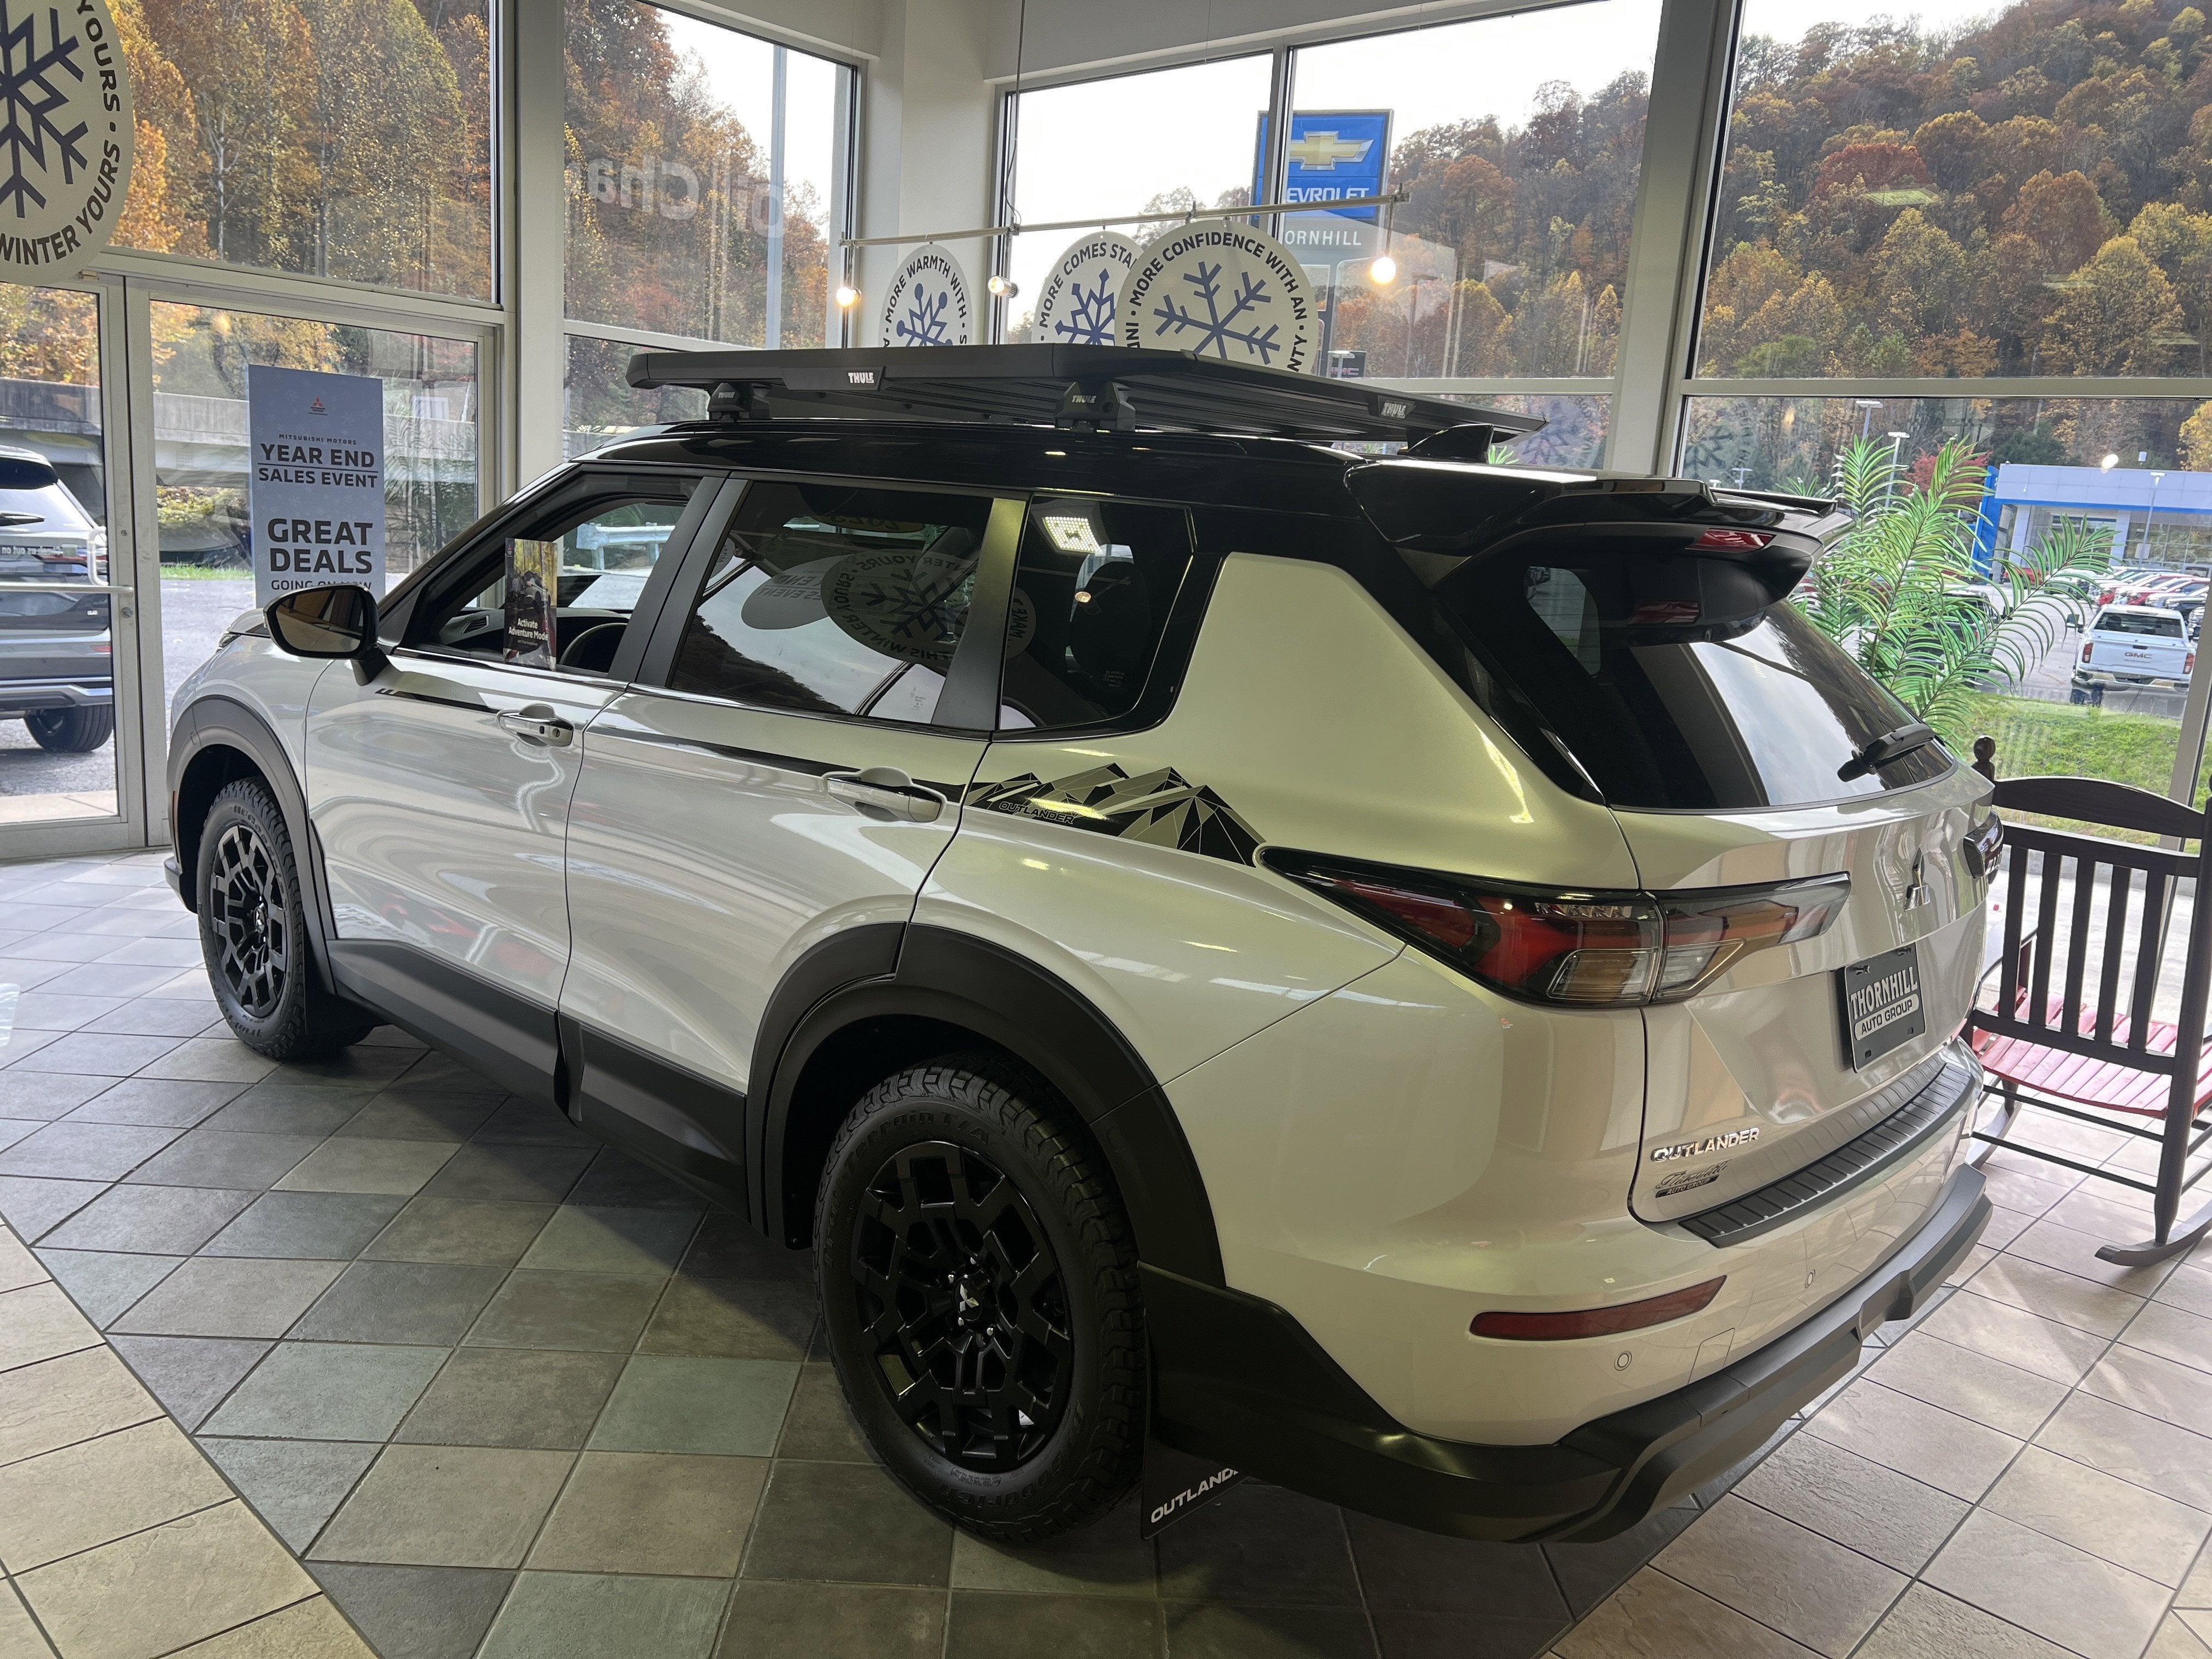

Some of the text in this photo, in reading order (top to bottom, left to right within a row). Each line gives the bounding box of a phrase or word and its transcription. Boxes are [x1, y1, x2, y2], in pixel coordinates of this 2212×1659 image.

[76, 140, 120, 234] YOURS
[1284, 230, 1361, 245] ORNHILL
[1039, 274, 1063, 328] MORE
[1063, 242, 1107, 275] COMES
[1129, 232, 1307, 320] MORE CONFIDENCE WITH AN
[885, 255, 967, 324] MORE WARMTH WITH
[848, 372, 874, 383] THULE
[1072, 395, 1097, 403] THULE
[1381, 402, 1407, 419] THULE
[279, 433, 324, 443] MITSUBISHI
[259, 443, 374, 468] YEAR END
[258, 467, 378, 488] SALES EVENT
[268, 518, 373, 545] GREAT
[270, 548, 373, 574] DEALS
[508, 627, 549, 641] Adventure Mode
[517, 618, 538, 629] Activate
[999, 801, 1075, 825] OUTLANDER
[1849, 966, 1918, 1020] THORNHILL
[1861, 998, 1913, 1035] AUTO GROUP
[1650, 1127, 1760, 1162] OUTLANDER
[1666, 1178, 1711, 1195] AUTO GROUP
[1151, 1468, 1239, 1523] OUTLAND
